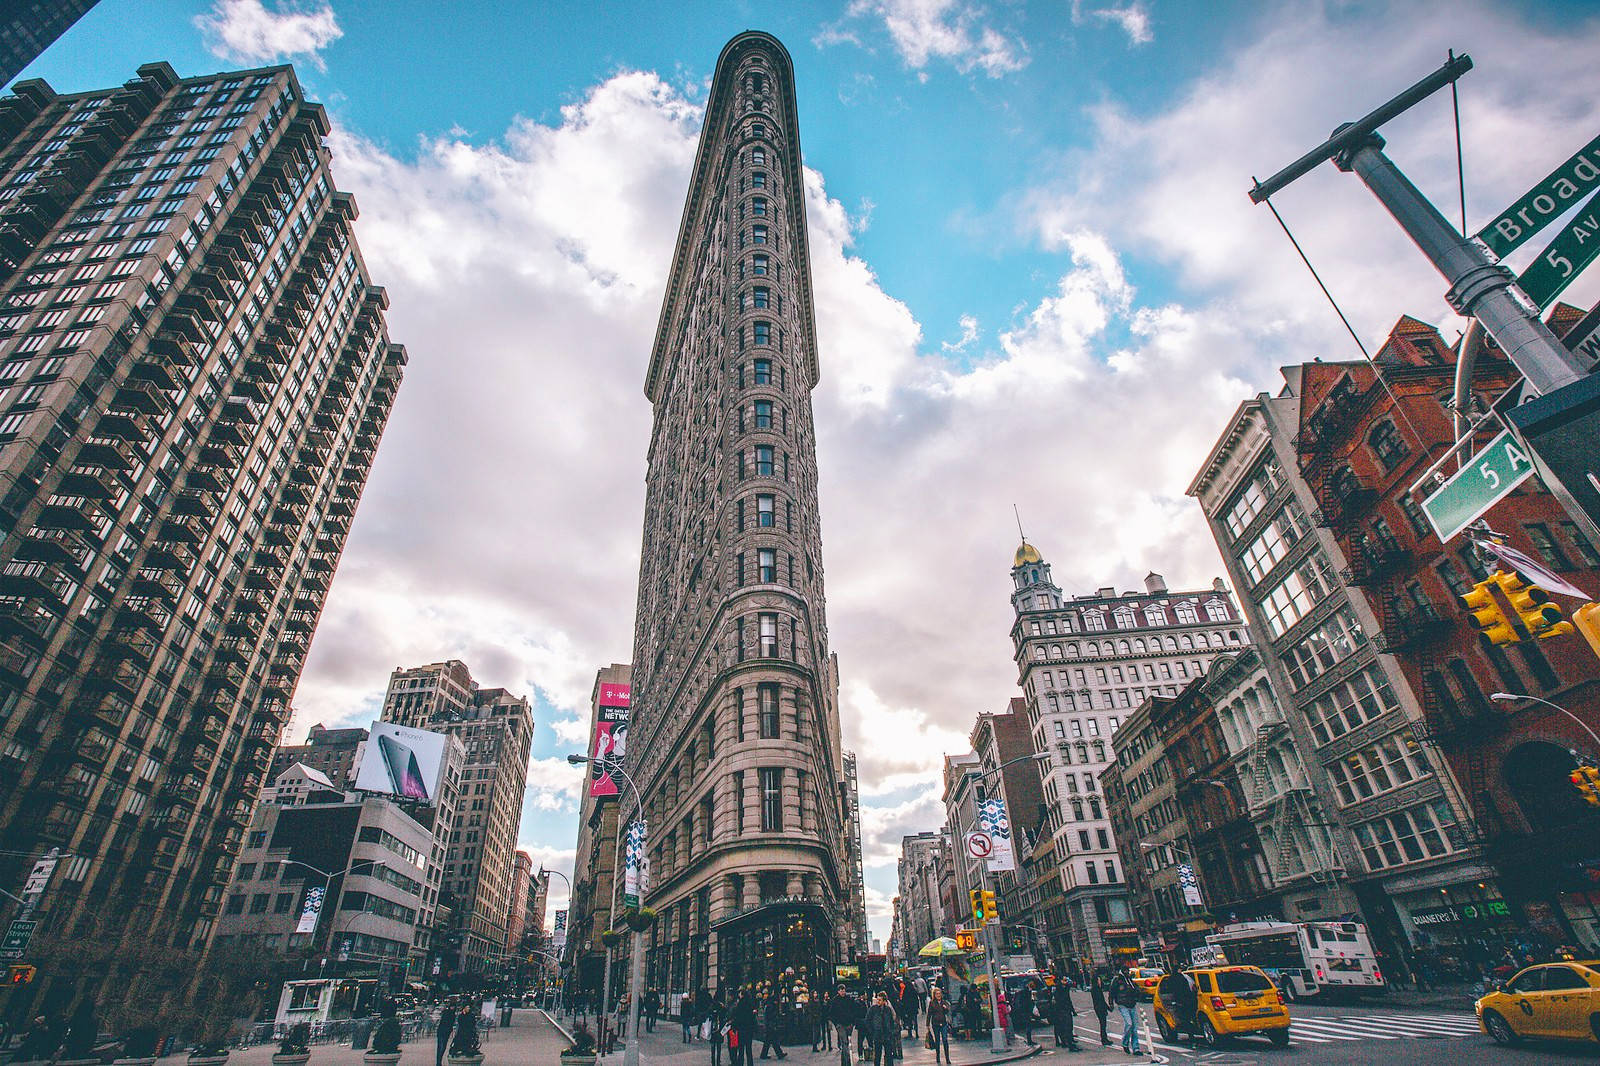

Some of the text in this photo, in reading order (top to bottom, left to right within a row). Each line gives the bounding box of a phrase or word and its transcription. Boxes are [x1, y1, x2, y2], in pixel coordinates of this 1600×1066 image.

[1546, 248, 1574, 278] 5
[1479, 461, 1501, 490] 5
[9, 930, 32, 938] Streets
[13, 922, 33, 930] Local
